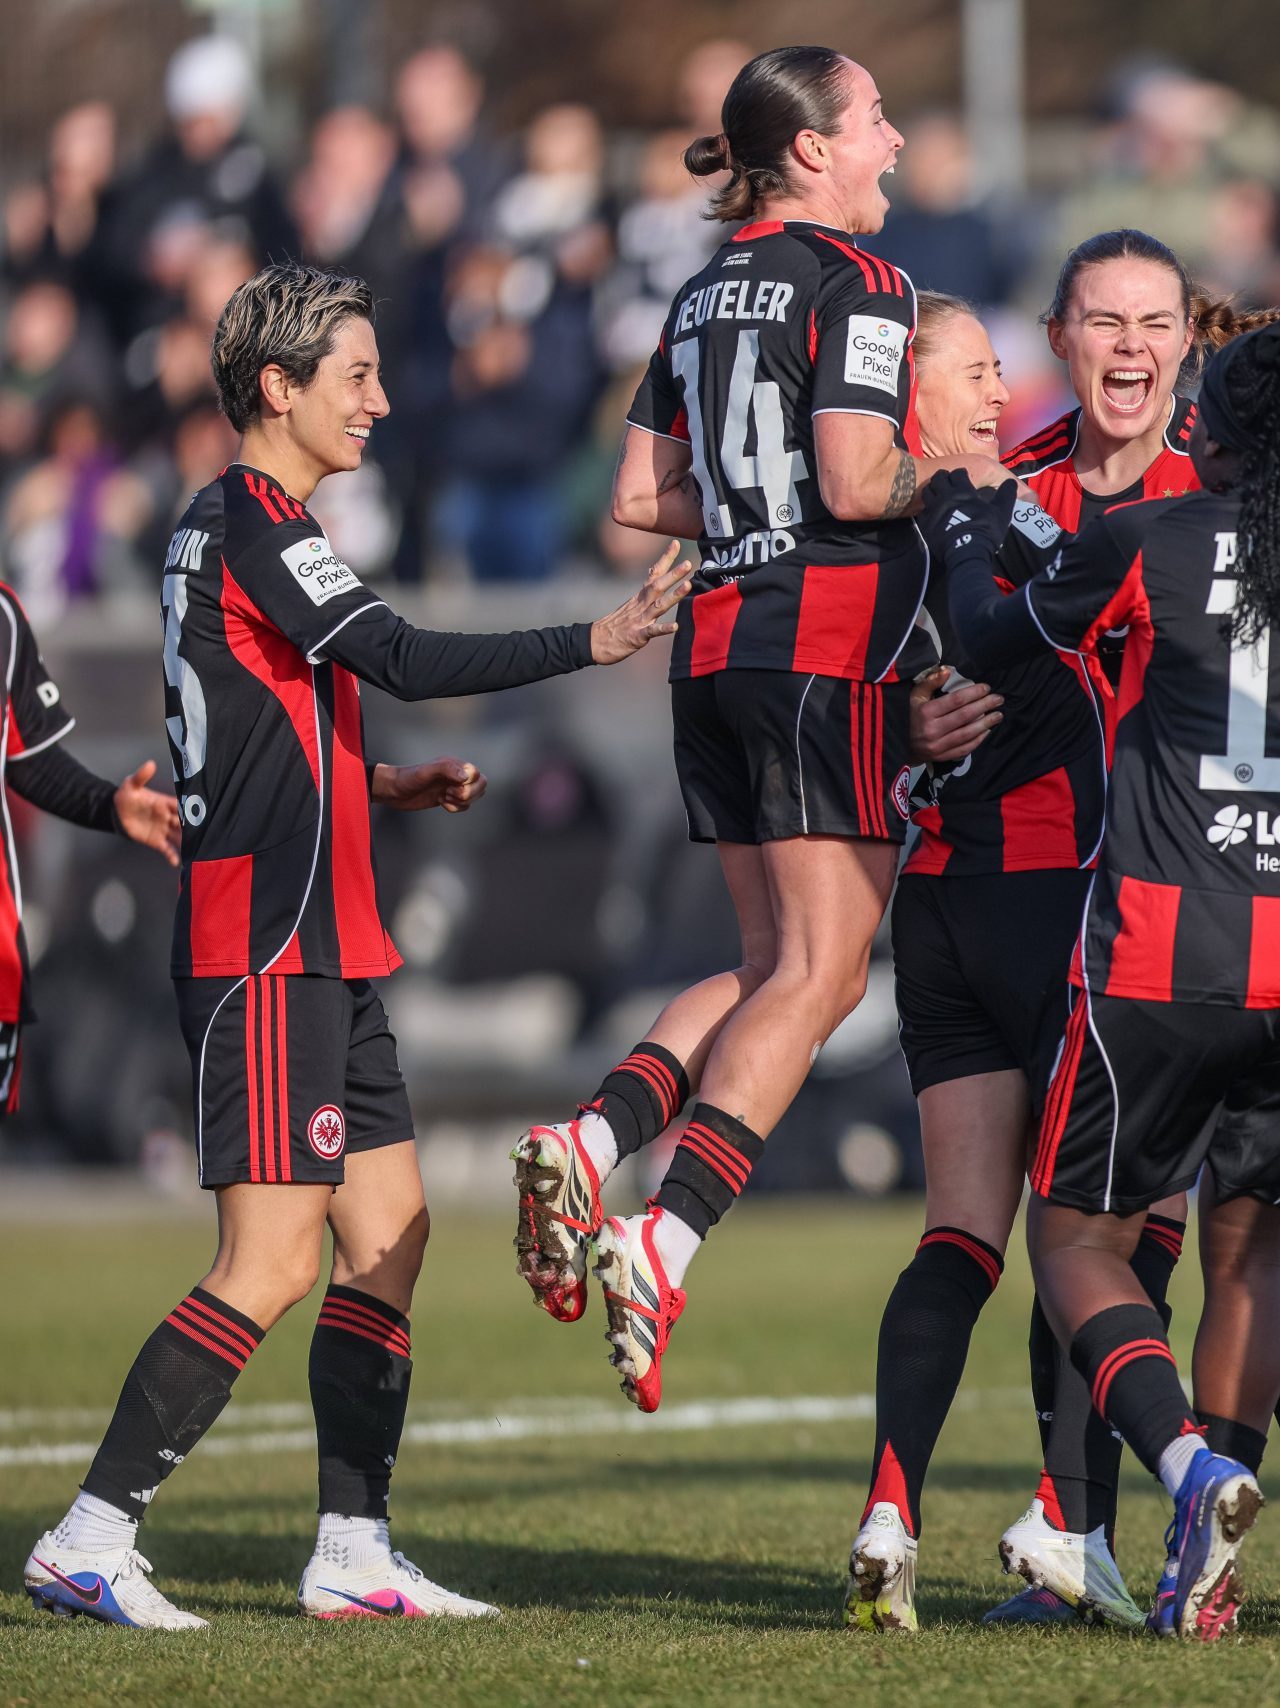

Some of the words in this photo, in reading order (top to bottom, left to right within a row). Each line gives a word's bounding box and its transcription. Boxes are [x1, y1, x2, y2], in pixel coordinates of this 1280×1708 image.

[853, 336, 899, 361] Google
[862, 356, 893, 378] Pixel
[671, 329, 809, 538] 14
[1013, 504, 1046, 523] Goo
[1034, 516, 1057, 534] Pix
